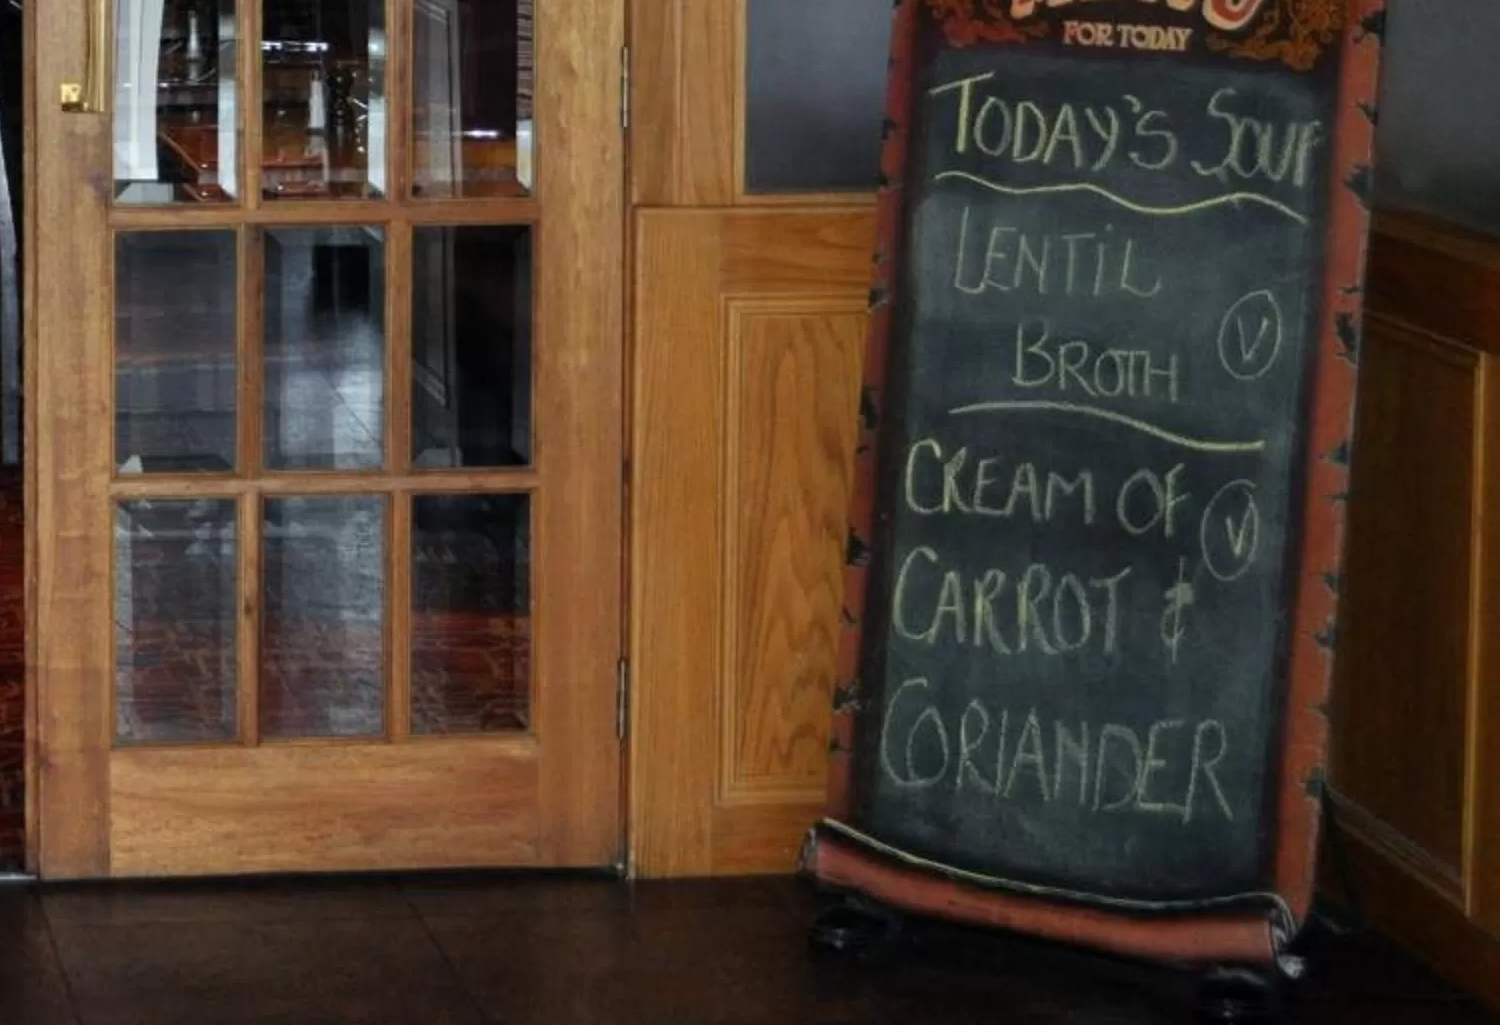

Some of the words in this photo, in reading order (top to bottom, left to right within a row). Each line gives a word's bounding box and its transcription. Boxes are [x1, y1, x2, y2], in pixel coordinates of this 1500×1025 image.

[1063, 19, 1114, 47] FOR
[1116, 23, 1193, 52] TODAY
[931, 72, 1177, 171] TODAY'S
[1012, 318, 1178, 402] BROTH
[905, 438, 1094, 524] CREAM
[1116, 463, 1192, 537] OF
[892, 544, 1132, 656] CARROT
[879, 678, 1234, 825] CORIANDER
